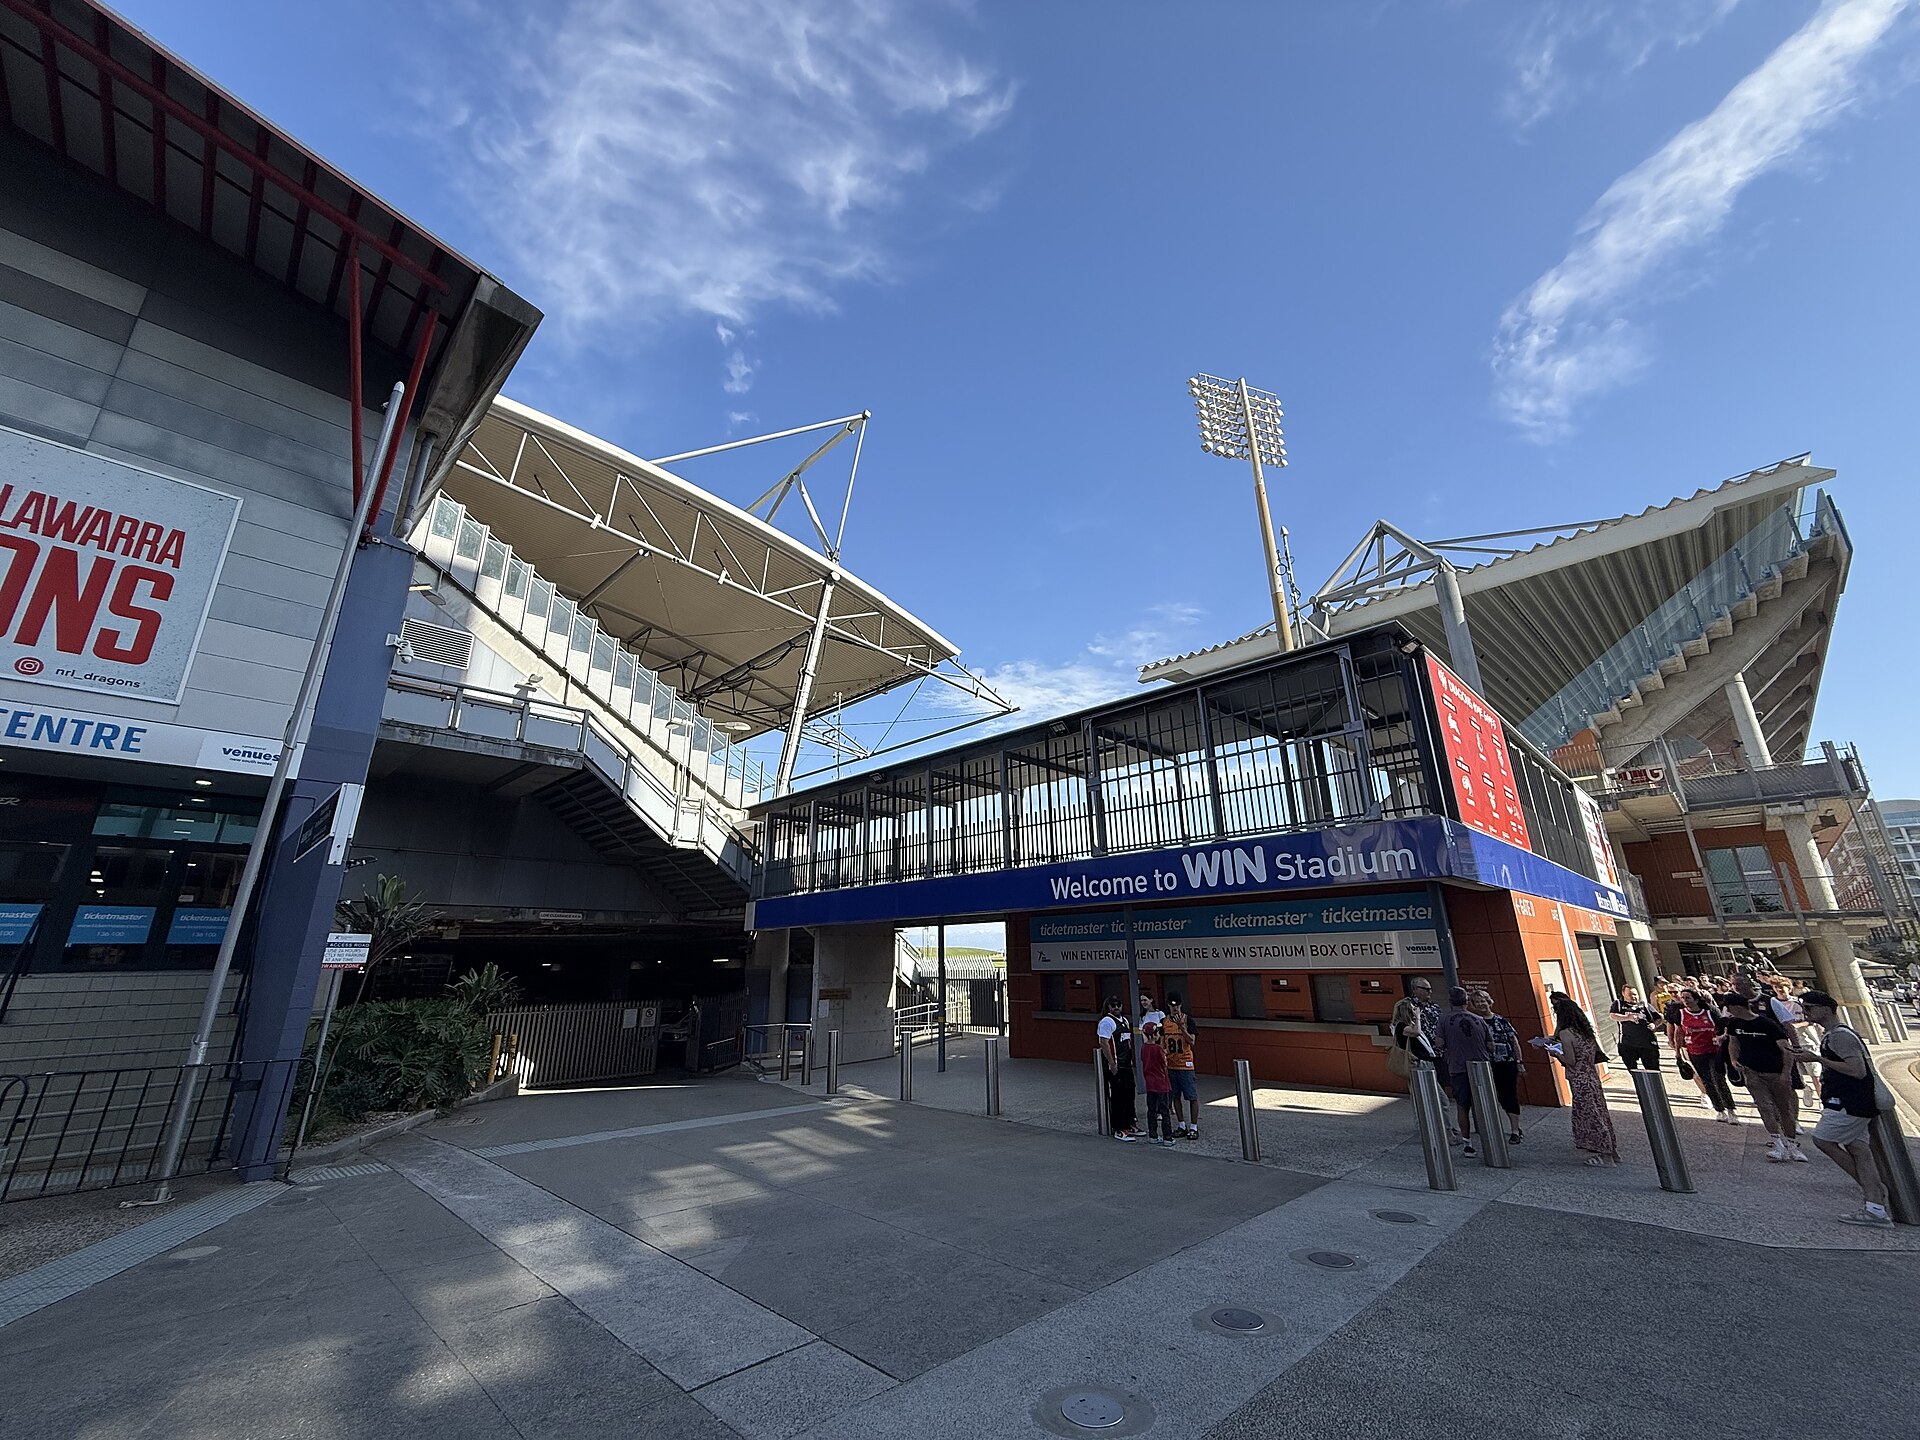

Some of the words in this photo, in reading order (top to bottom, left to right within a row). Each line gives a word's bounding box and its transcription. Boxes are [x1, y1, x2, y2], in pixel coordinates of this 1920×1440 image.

[55, 668, 141, 688] nrl_dragons
[0, 708, 147, 753] ENTRE
[222, 747, 281, 762] venues
[1050, 875, 1148, 900] Welcome
[1153, 869, 1177, 891] to
[1181, 845, 1267, 889] WIN
[1275, 846, 1417, 881] Stadium
[83, 912, 145, 920] ticketmaster
[180, 914, 229, 922] ticketmaste
[1040, 921, 1104, 936] ticketmaster
[1111, 919, 1187, 933] ticetmaster
[1213, 912, 1307, 929] ticketmaster
[1060, 950, 1078, 961] WIN
[1164, 945, 1208, 960] CENTRE
[1211, 945, 1220, 958] &
[1221, 946, 1247, 958] WIN
[1249, 945, 1305, 958] STADIUM
[1310, 944, 1339, 957] BOX
[1341, 942, 1394, 956] OFFICE
